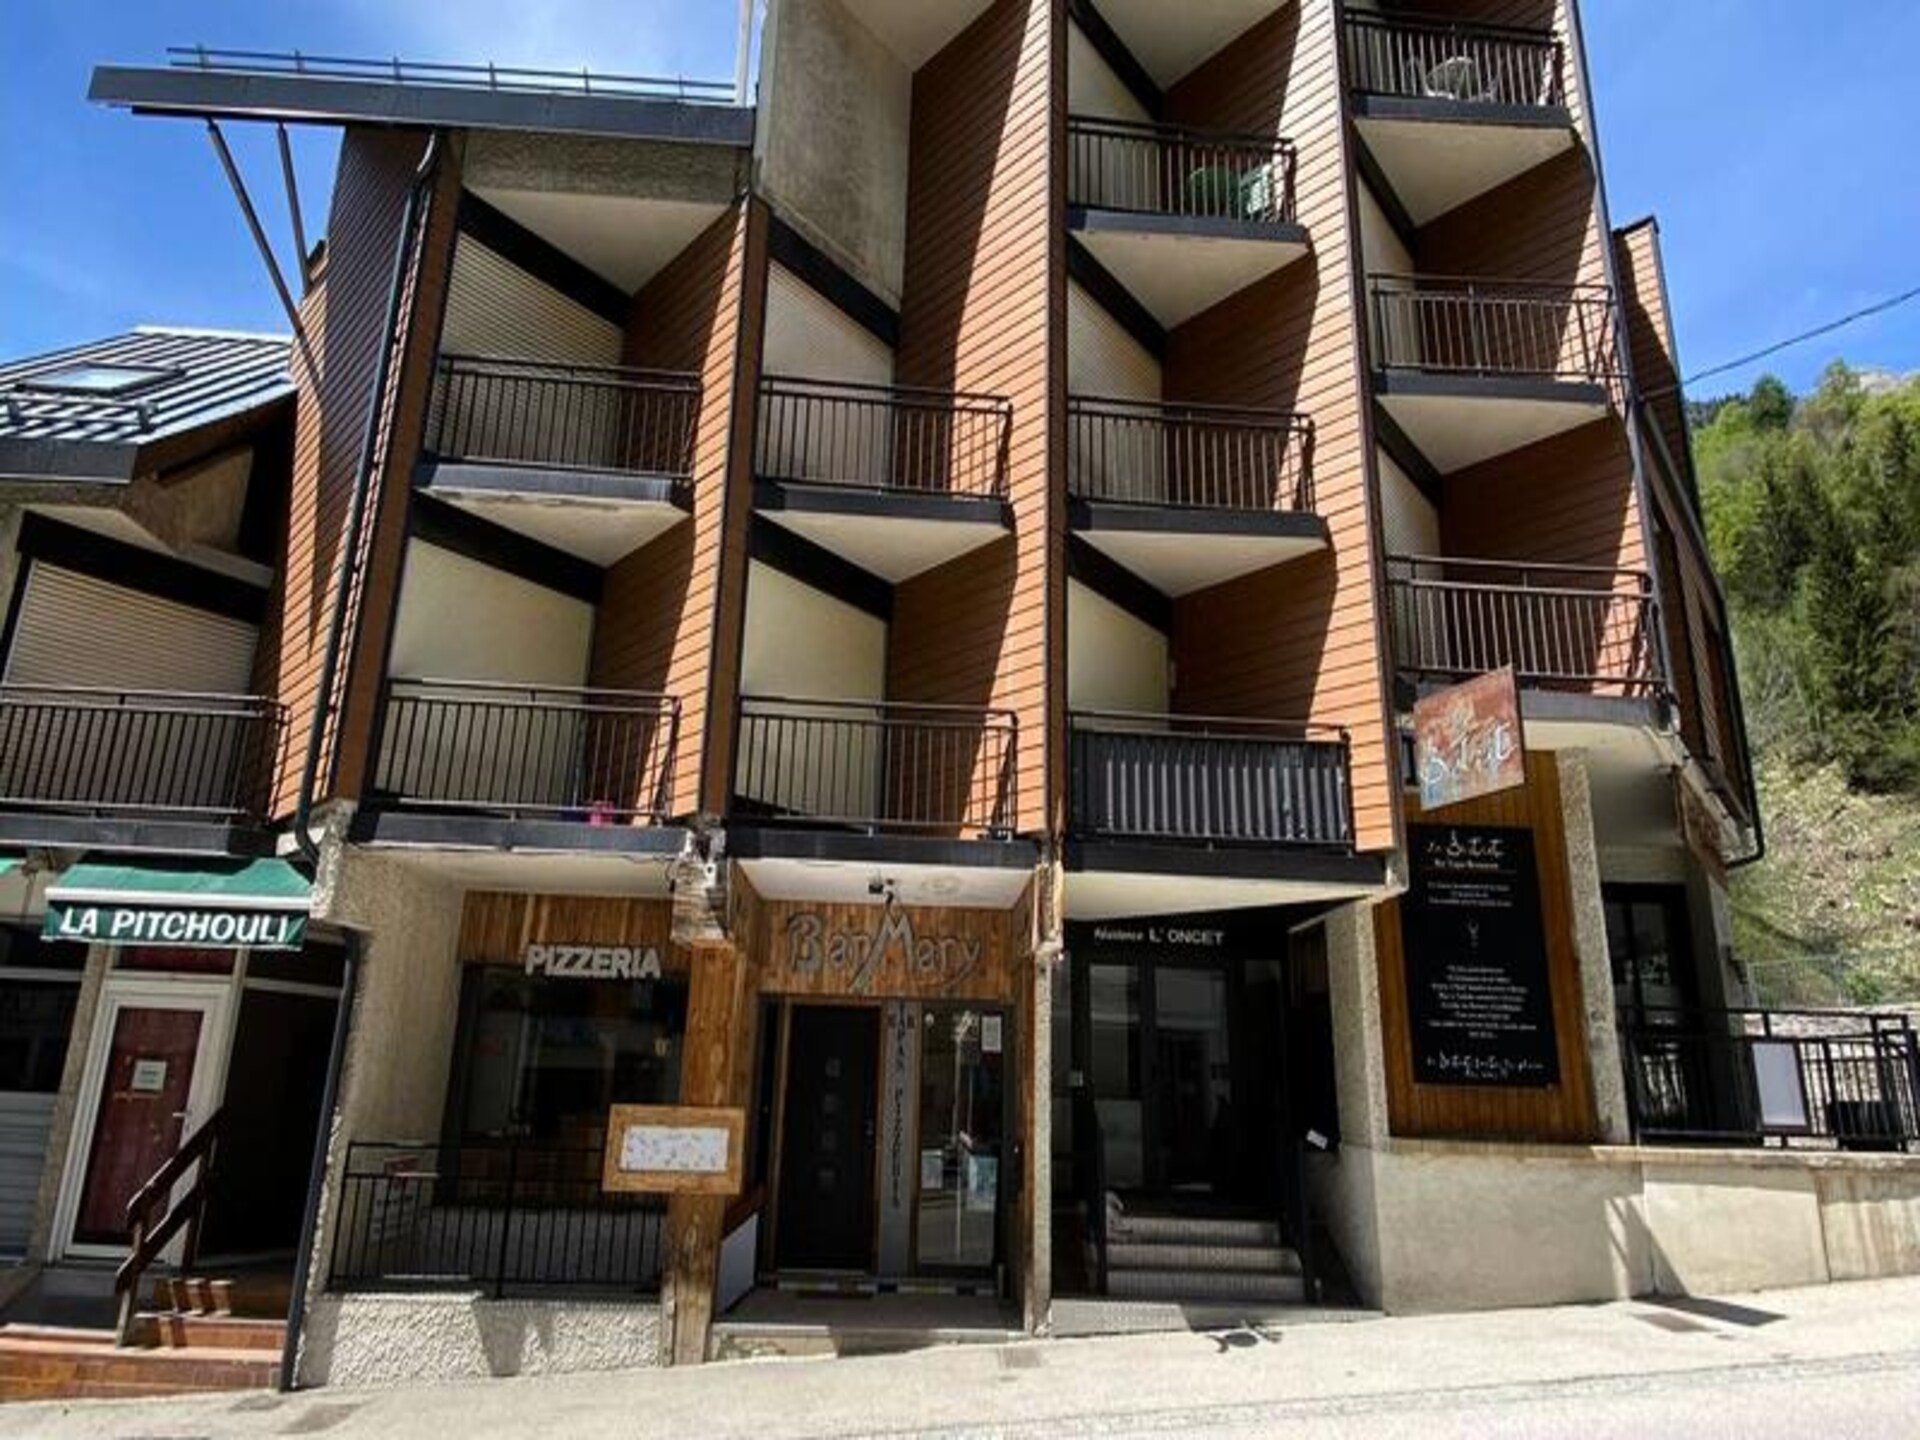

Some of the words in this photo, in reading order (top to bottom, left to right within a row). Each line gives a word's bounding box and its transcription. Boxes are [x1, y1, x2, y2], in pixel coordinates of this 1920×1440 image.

[60, 908, 97, 935] LA
[110, 911, 288, 943] PITCHOULI
[525, 945, 661, 979] PIZZERIA
